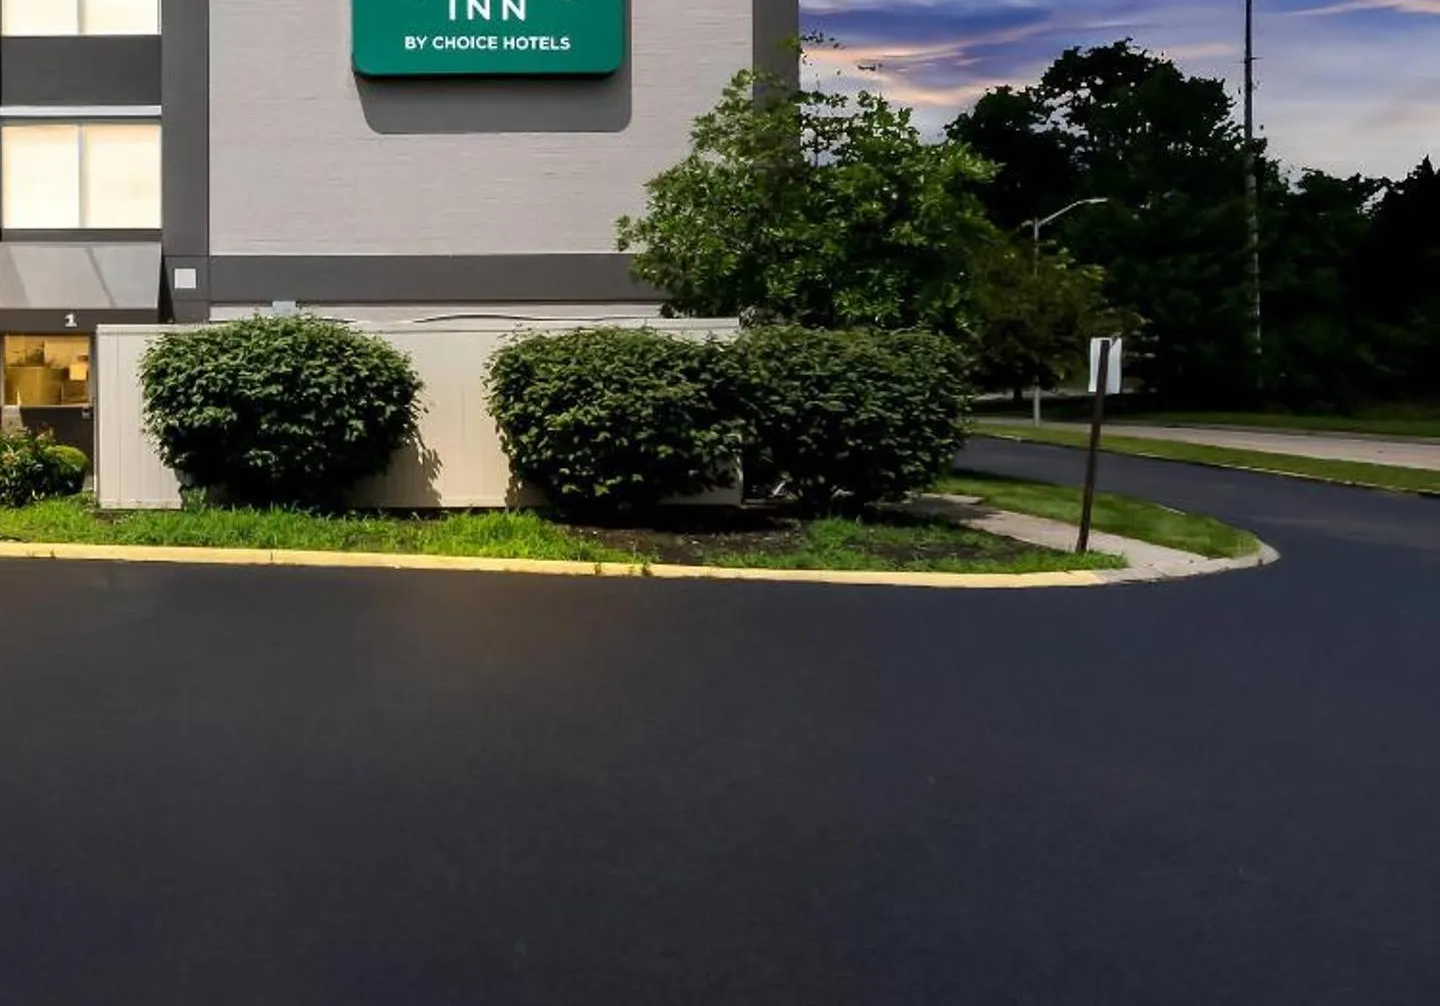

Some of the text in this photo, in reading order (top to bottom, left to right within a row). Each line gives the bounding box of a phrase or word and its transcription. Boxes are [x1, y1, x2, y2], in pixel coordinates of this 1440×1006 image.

[405, 36, 570, 50] BY CHOICE HOTELS
[66, 314, 77, 326] 1
